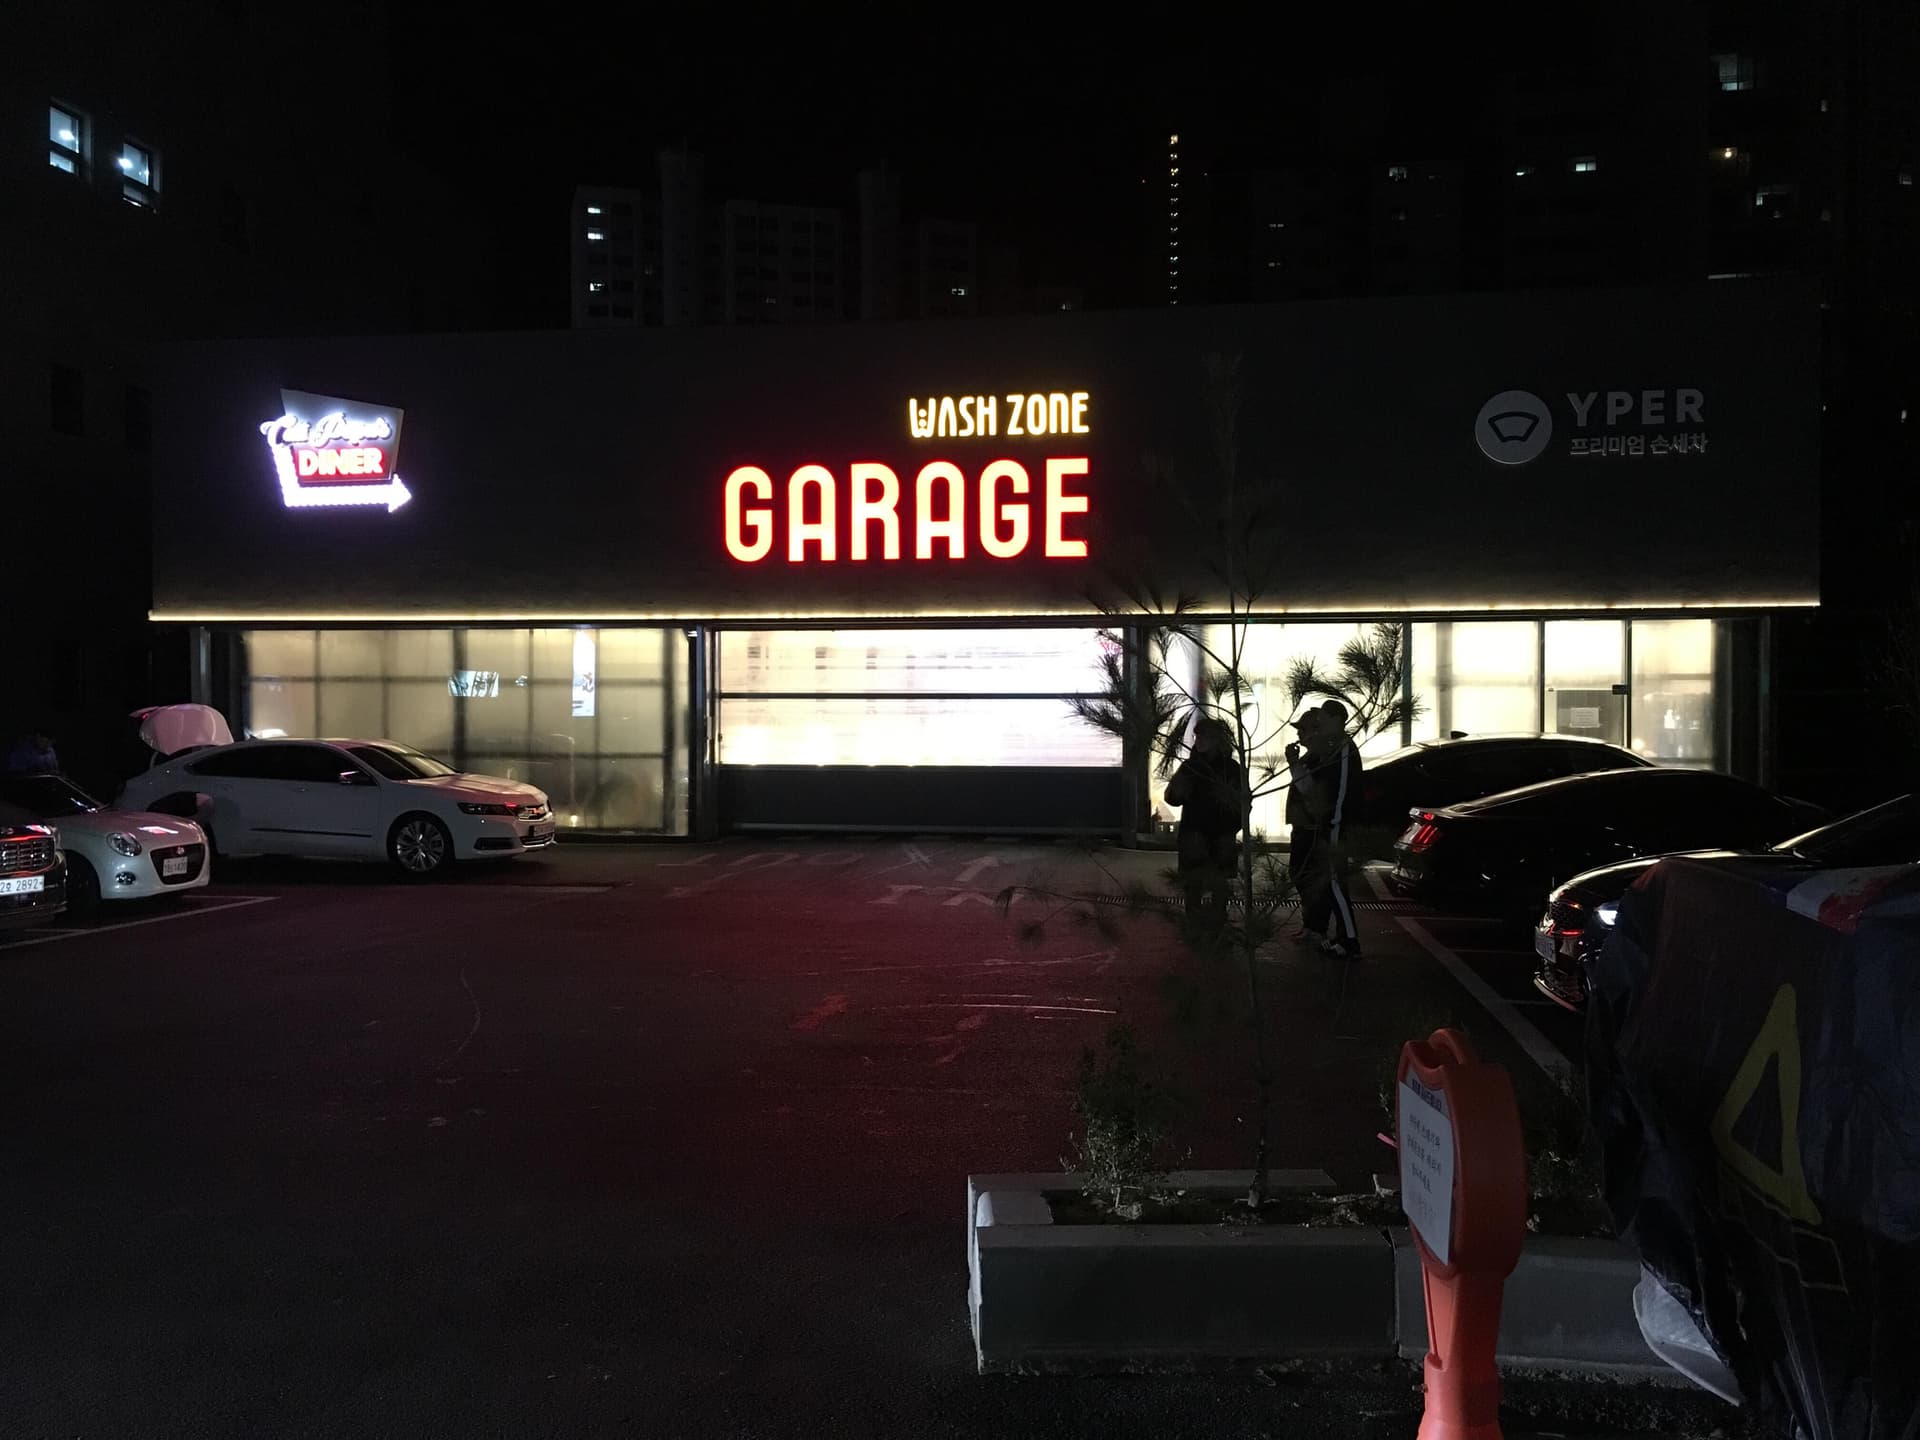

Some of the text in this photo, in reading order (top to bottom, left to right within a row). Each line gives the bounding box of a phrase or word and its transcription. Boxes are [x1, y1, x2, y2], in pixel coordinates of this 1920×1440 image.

[909, 392, 1090, 439] WASH ZONE
[1565, 387, 1705, 428] YPER
[299, 447, 384, 477] DINER
[1569, 431, 1709, 457] 프리미엄 손세차
[724, 456, 1090, 563] GARAGE
